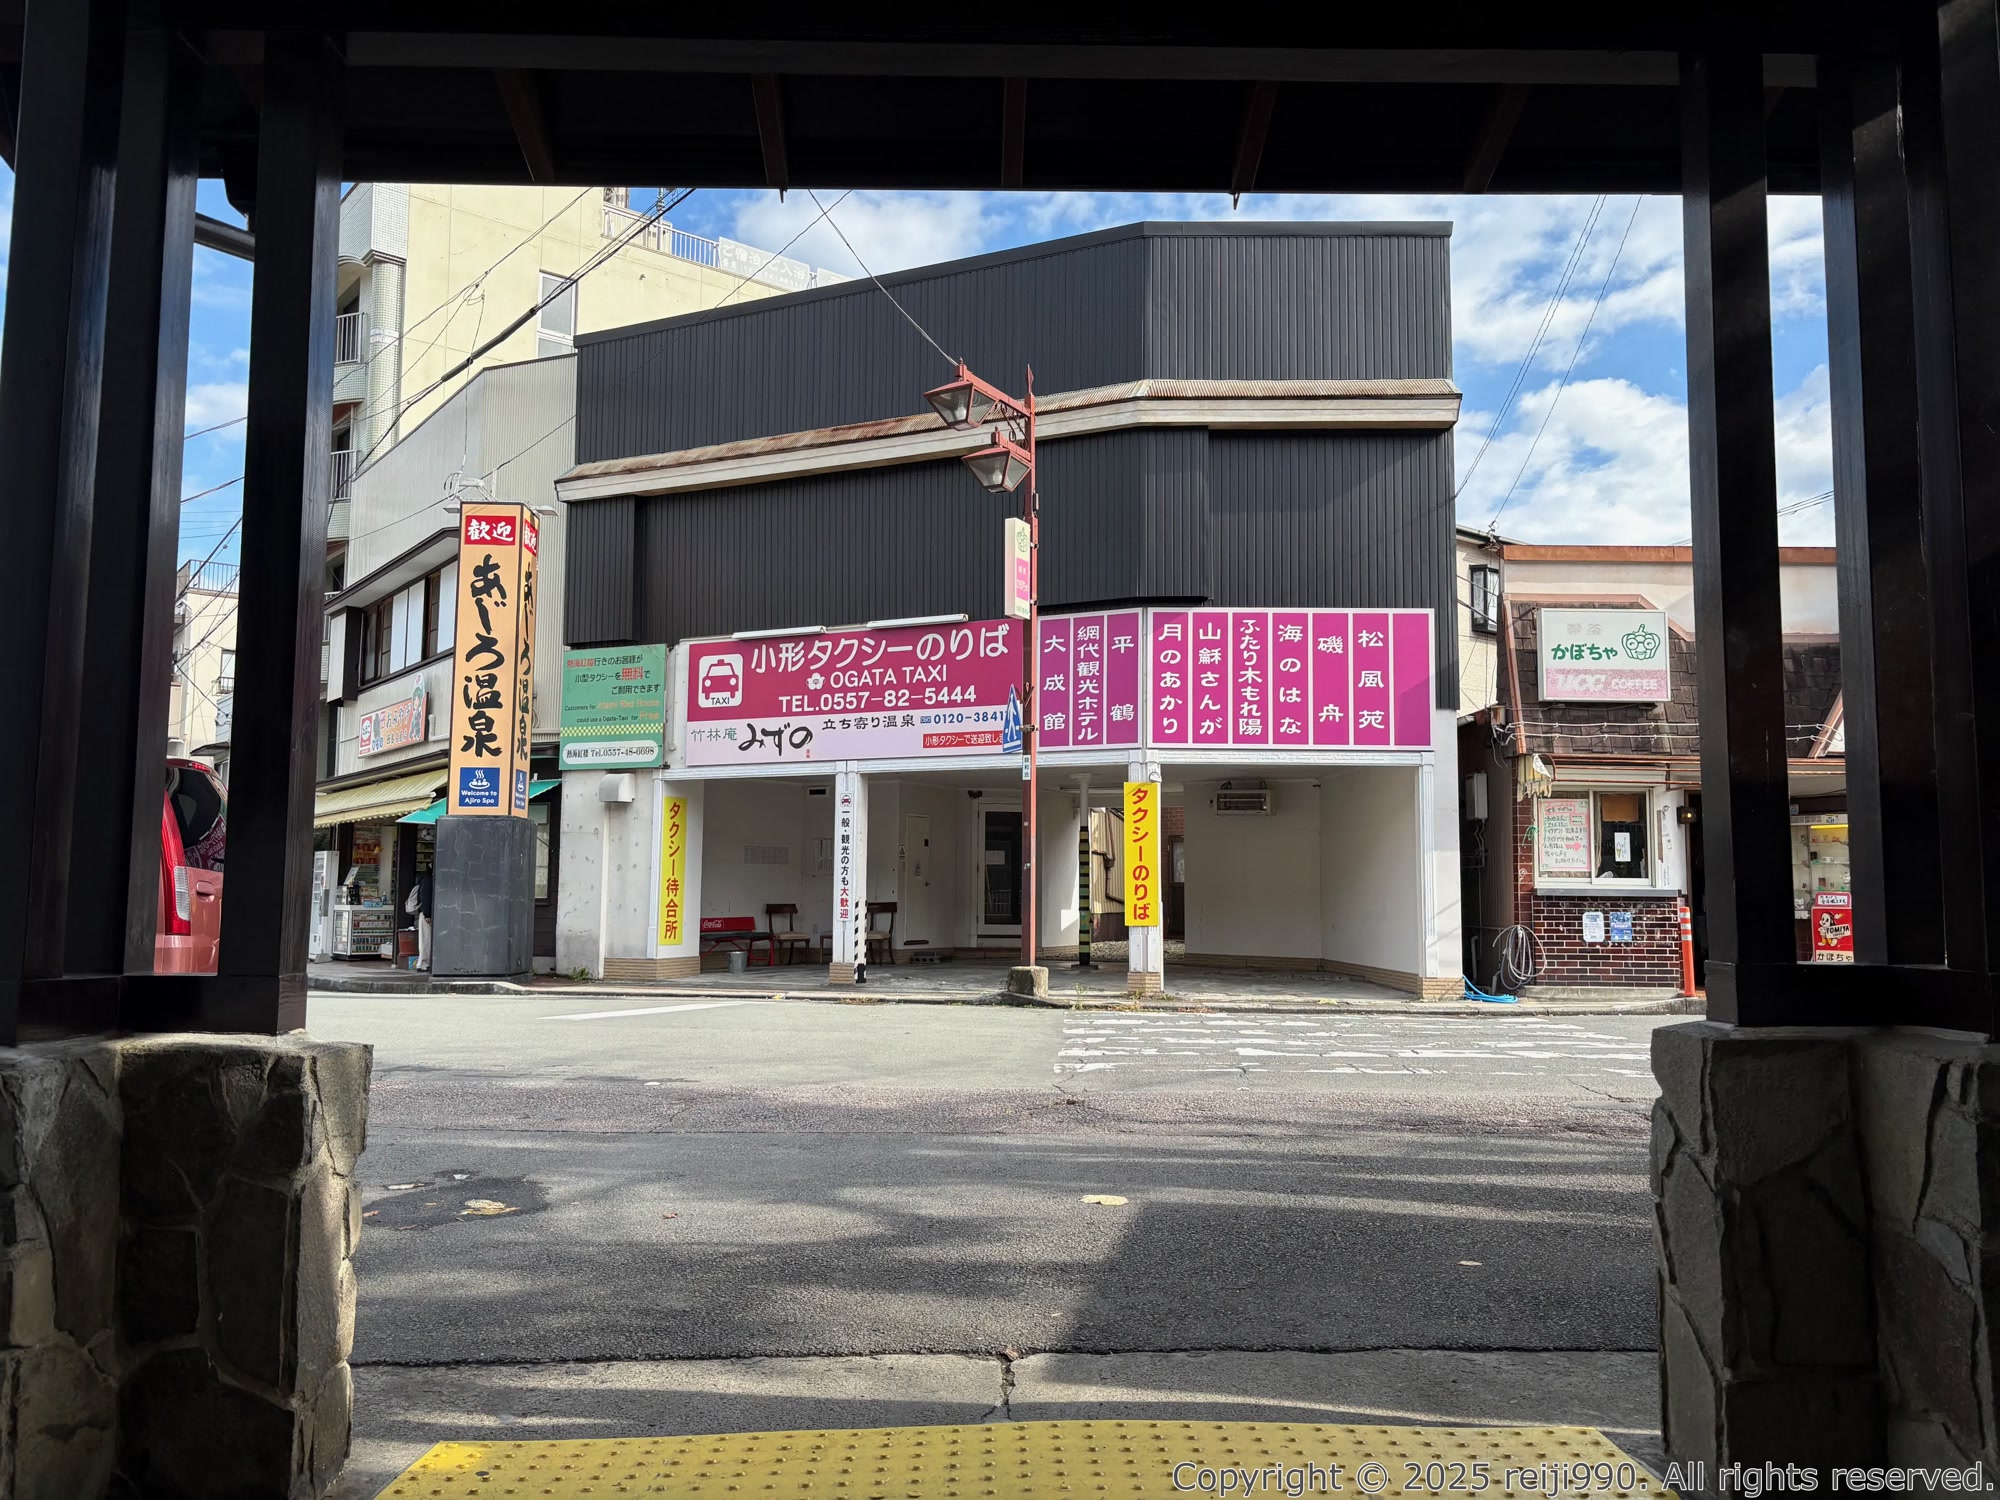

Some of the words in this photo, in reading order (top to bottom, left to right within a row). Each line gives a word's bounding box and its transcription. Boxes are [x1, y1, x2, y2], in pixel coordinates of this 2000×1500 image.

[466, 520, 514, 542] 歓迎
[524, 525, 538, 553] 歓迎
[461, 553, 507, 757] あじろ温泉
[516, 562, 533, 761] あじろ温泉
[751, 624, 1009, 673] 小形タクシーのりば
[1551, 643, 1618, 661] かぼちゃ
[611, 684, 660, 695] ご利用できます
[830, 667, 894, 688] OGATA
[902, 664, 947, 684] TAXI
[1043, 634, 1067, 731] 大成館
[1077, 625, 1100, 741] 網代観光ホテル
[1110, 634, 1135, 722] 平鶴
[1158, 623, 1183, 734] 月のあかり
[1238, 619, 1263, 736] ふたり木もれ陽
[1279, 624, 1303, 735] 海のはな
[1318, 635, 1344, 723] 磯舟
[1358, 630, 1385, 729] 松風苑
[1611, 678, 1657, 690] COFFEE
[640, 711, 660, 720] Free
[710, 696, 730, 706] TAXI
[822, 713, 915, 730] 立ち寄り温泉
[934, 711, 1007, 725] 0120-3841
[691, 727, 737, 742] 竹林庵
[738, 722, 813, 757] みずの
[664, 802, 682, 940] タクシー待合所
[839, 809, 851, 919] 一般・観光の方も大歓迎
[1131, 787, 1151, 921] タクシーのりば
[1826, 926, 1850, 935] TOMIYA
[1817, 953, 1852, 962] かぼちゃ
